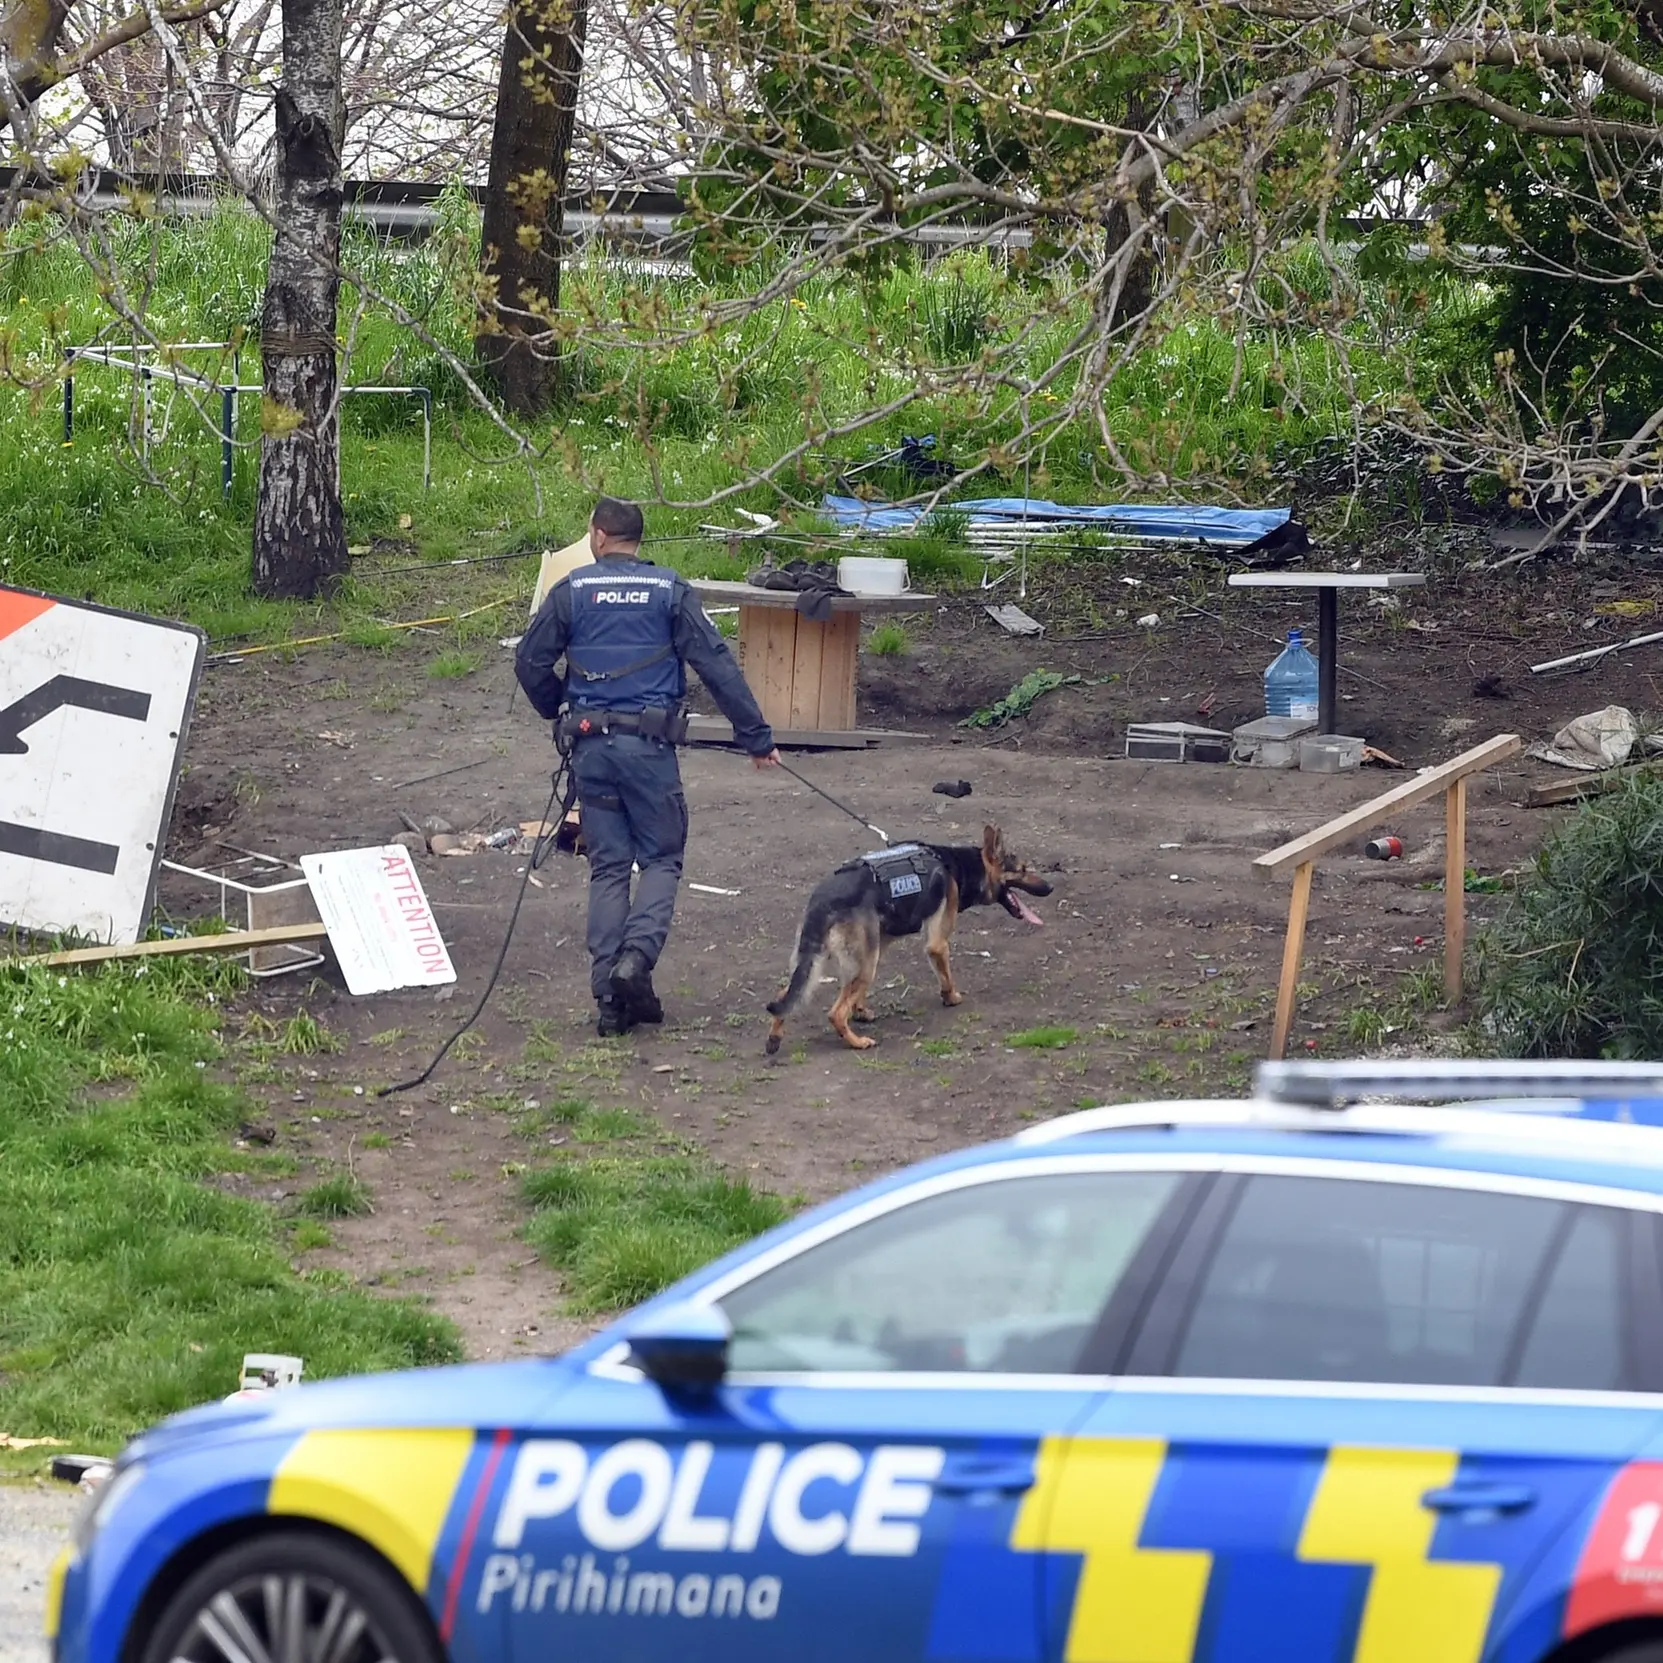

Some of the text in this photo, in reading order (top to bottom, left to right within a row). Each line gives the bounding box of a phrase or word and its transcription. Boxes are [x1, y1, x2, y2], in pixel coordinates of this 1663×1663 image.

[596, 591, 650, 604] POLICE
[381, 856, 448, 973] ATTENTION
[493, 1438, 946, 1556] POLICE
[1620, 1502, 1663, 1562] 1
[476, 1551, 782, 1619] Pirihimana
